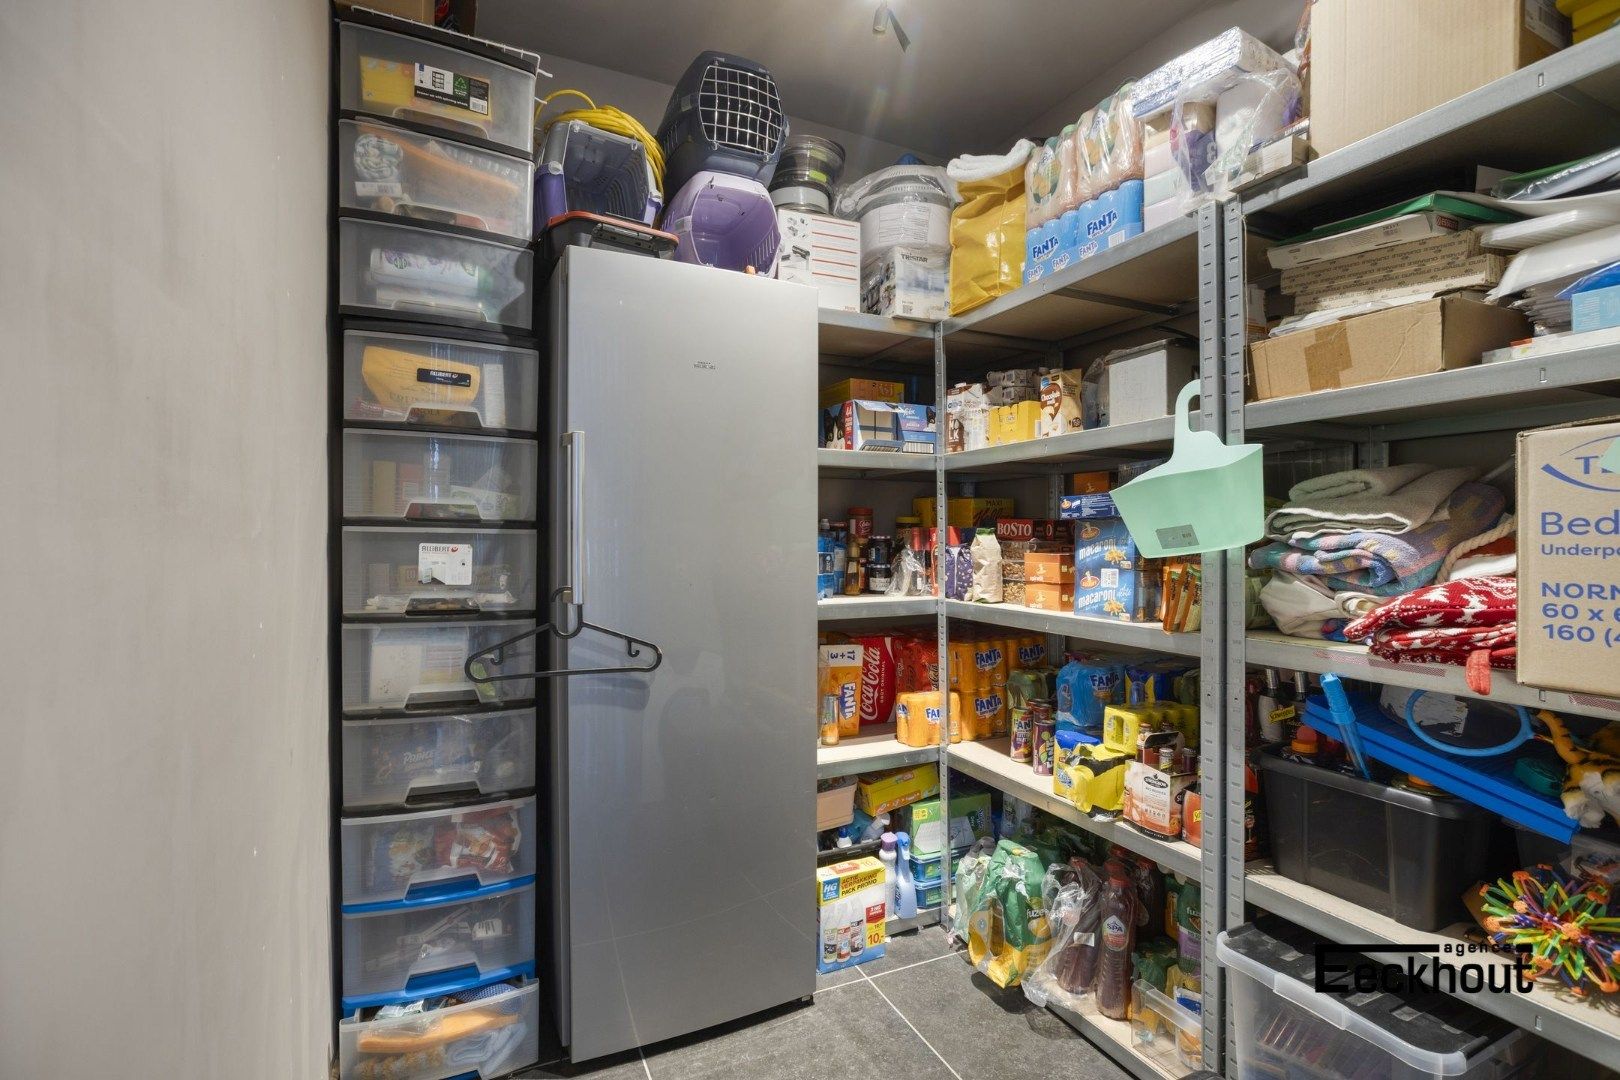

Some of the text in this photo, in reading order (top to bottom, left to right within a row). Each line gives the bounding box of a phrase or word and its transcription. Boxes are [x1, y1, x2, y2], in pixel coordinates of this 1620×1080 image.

[1087, 210, 1118, 236] FANTA
[1032, 236, 1059, 258] FANTA
[997, 523, 1032, 537] BOSTO
[1541, 509, 1620, 536] Bed
[1079, 538, 1116, 560] macaroni
[1078, 587, 1116, 609] macaroni
[1542, 603, 1579, 619] 60
[1588, 608, 1604, 622] x
[1542, 624, 1595, 643] 160
[847, 650, 855, 660] 17
[975, 649, 1002, 666] FANTA
[1019, 643, 1046, 660] FANTA
[1090, 672, 1120, 687] FANTA
[845, 682, 856, 719] FANTA
[975, 694, 1002, 712] FANTA
[824, 883, 837, 893] HG
[841, 878, 877, 896] PACK PROMO
[1106, 921, 1124, 933] SPA
